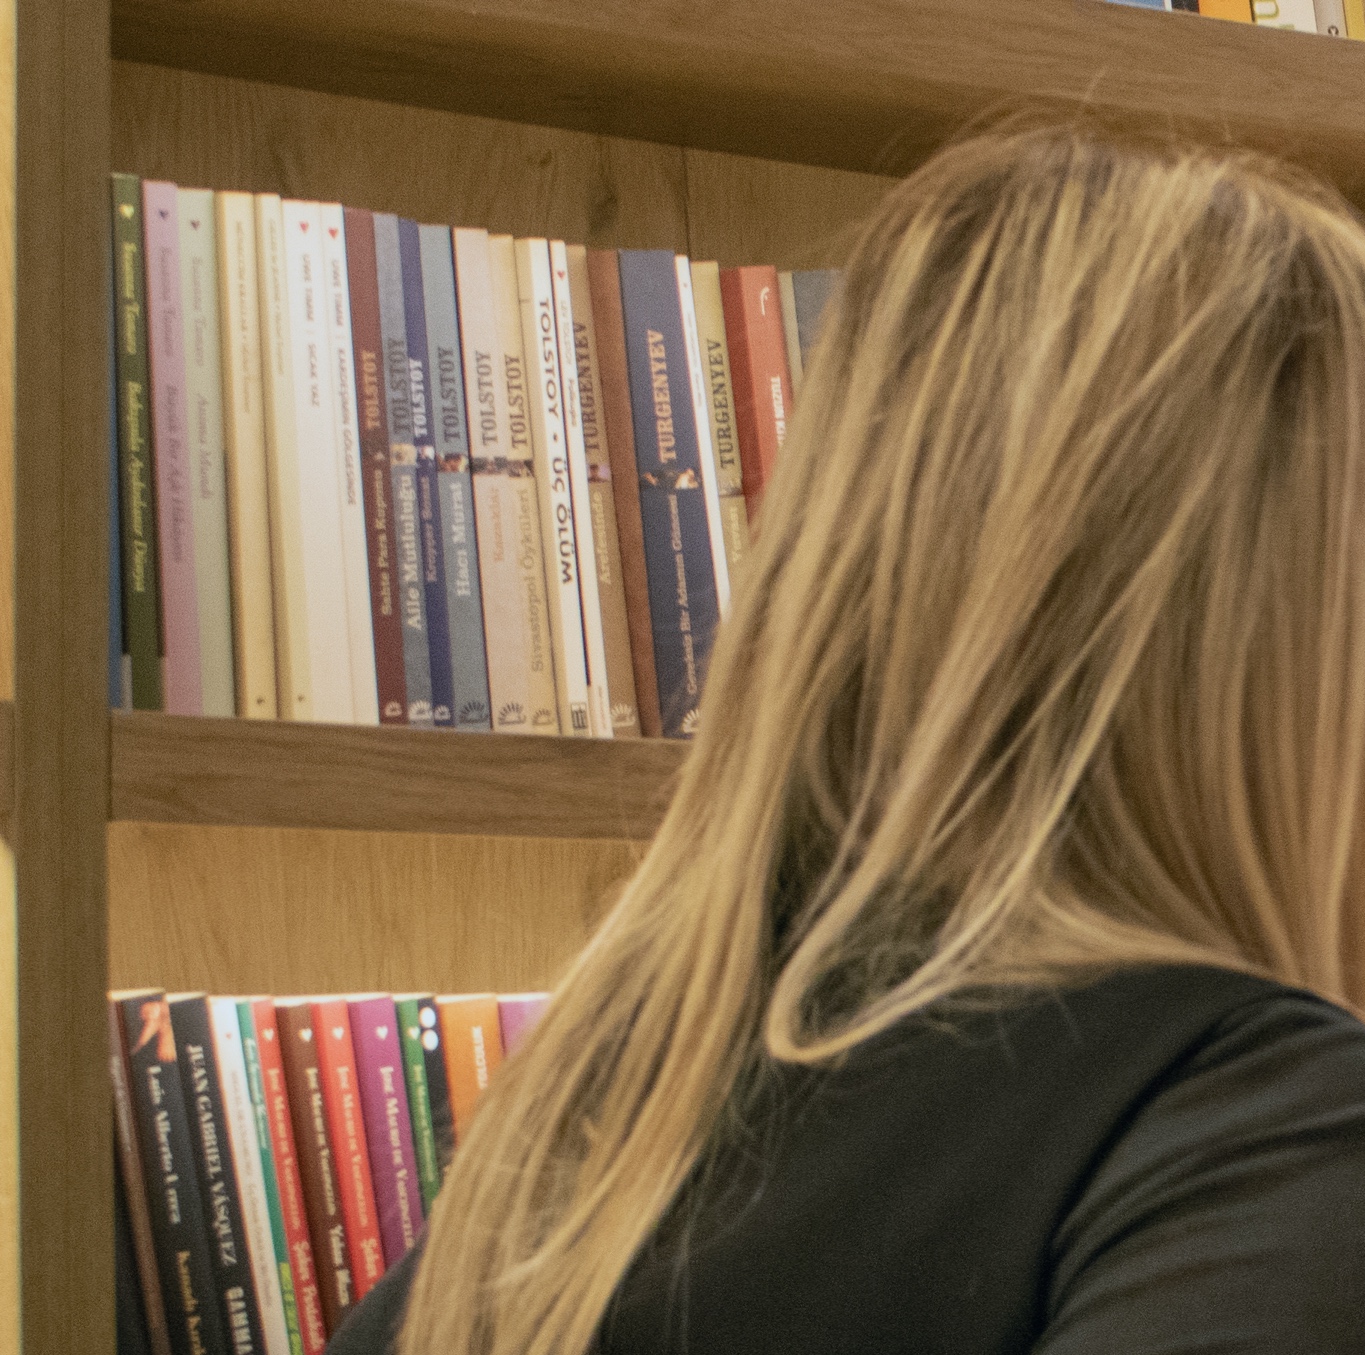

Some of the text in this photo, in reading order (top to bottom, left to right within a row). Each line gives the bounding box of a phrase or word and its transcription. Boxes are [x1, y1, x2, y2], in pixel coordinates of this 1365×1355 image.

[361, 350, 384, 430] TOLSTOY
[387, 337, 411, 435] TOLSTOY
[409, 358, 428, 438] TOLSTOY
[438, 347, 462, 443] TOLSTOY
[476, 350, 499, 446] TOLSTOY
[504, 353, 528, 449] TOLSTOY
[572, 321, 601, 452] TURGENYEV
[647, 329, 677, 464] TURGENYEV
[706, 339, 735, 469] TURGENYEV
[539, 298, 575, 584] TOLSTOY ÜÇ ÖLÜM
[398, 475, 422, 631] Aile Mutluluğu
[450, 481, 471, 597] Hacı Murat
[518, 488, 544, 673] Sivastopol Öyküleri
[187, 1044, 210, 1094] JUAN
[198, 1096, 222, 1179] GABRIEL
